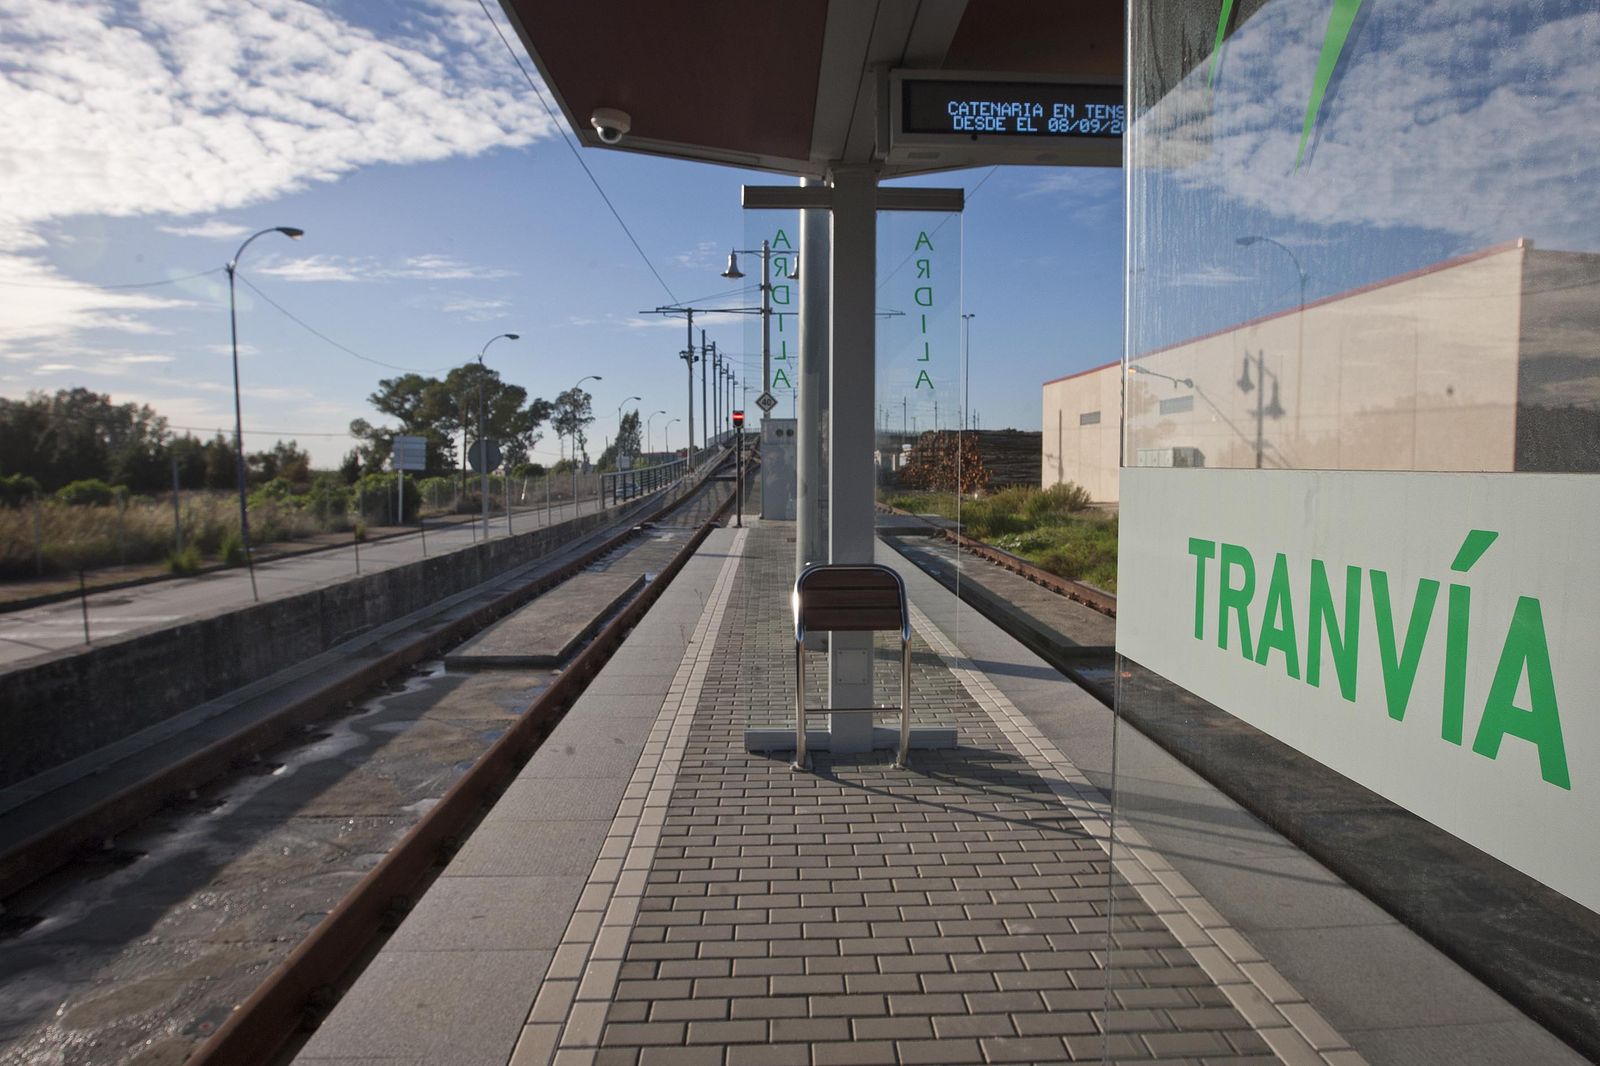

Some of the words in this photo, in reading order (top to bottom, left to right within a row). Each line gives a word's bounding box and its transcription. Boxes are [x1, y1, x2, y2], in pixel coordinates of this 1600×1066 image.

[948, 101, 1043, 117] CATENARIA
[1053, 103, 1074, 118] EN
[953, 116, 1006, 131] DESDE
[1017, 117, 1037, 131] EL
[1188, 529, 1571, 790] TRANVÍA
